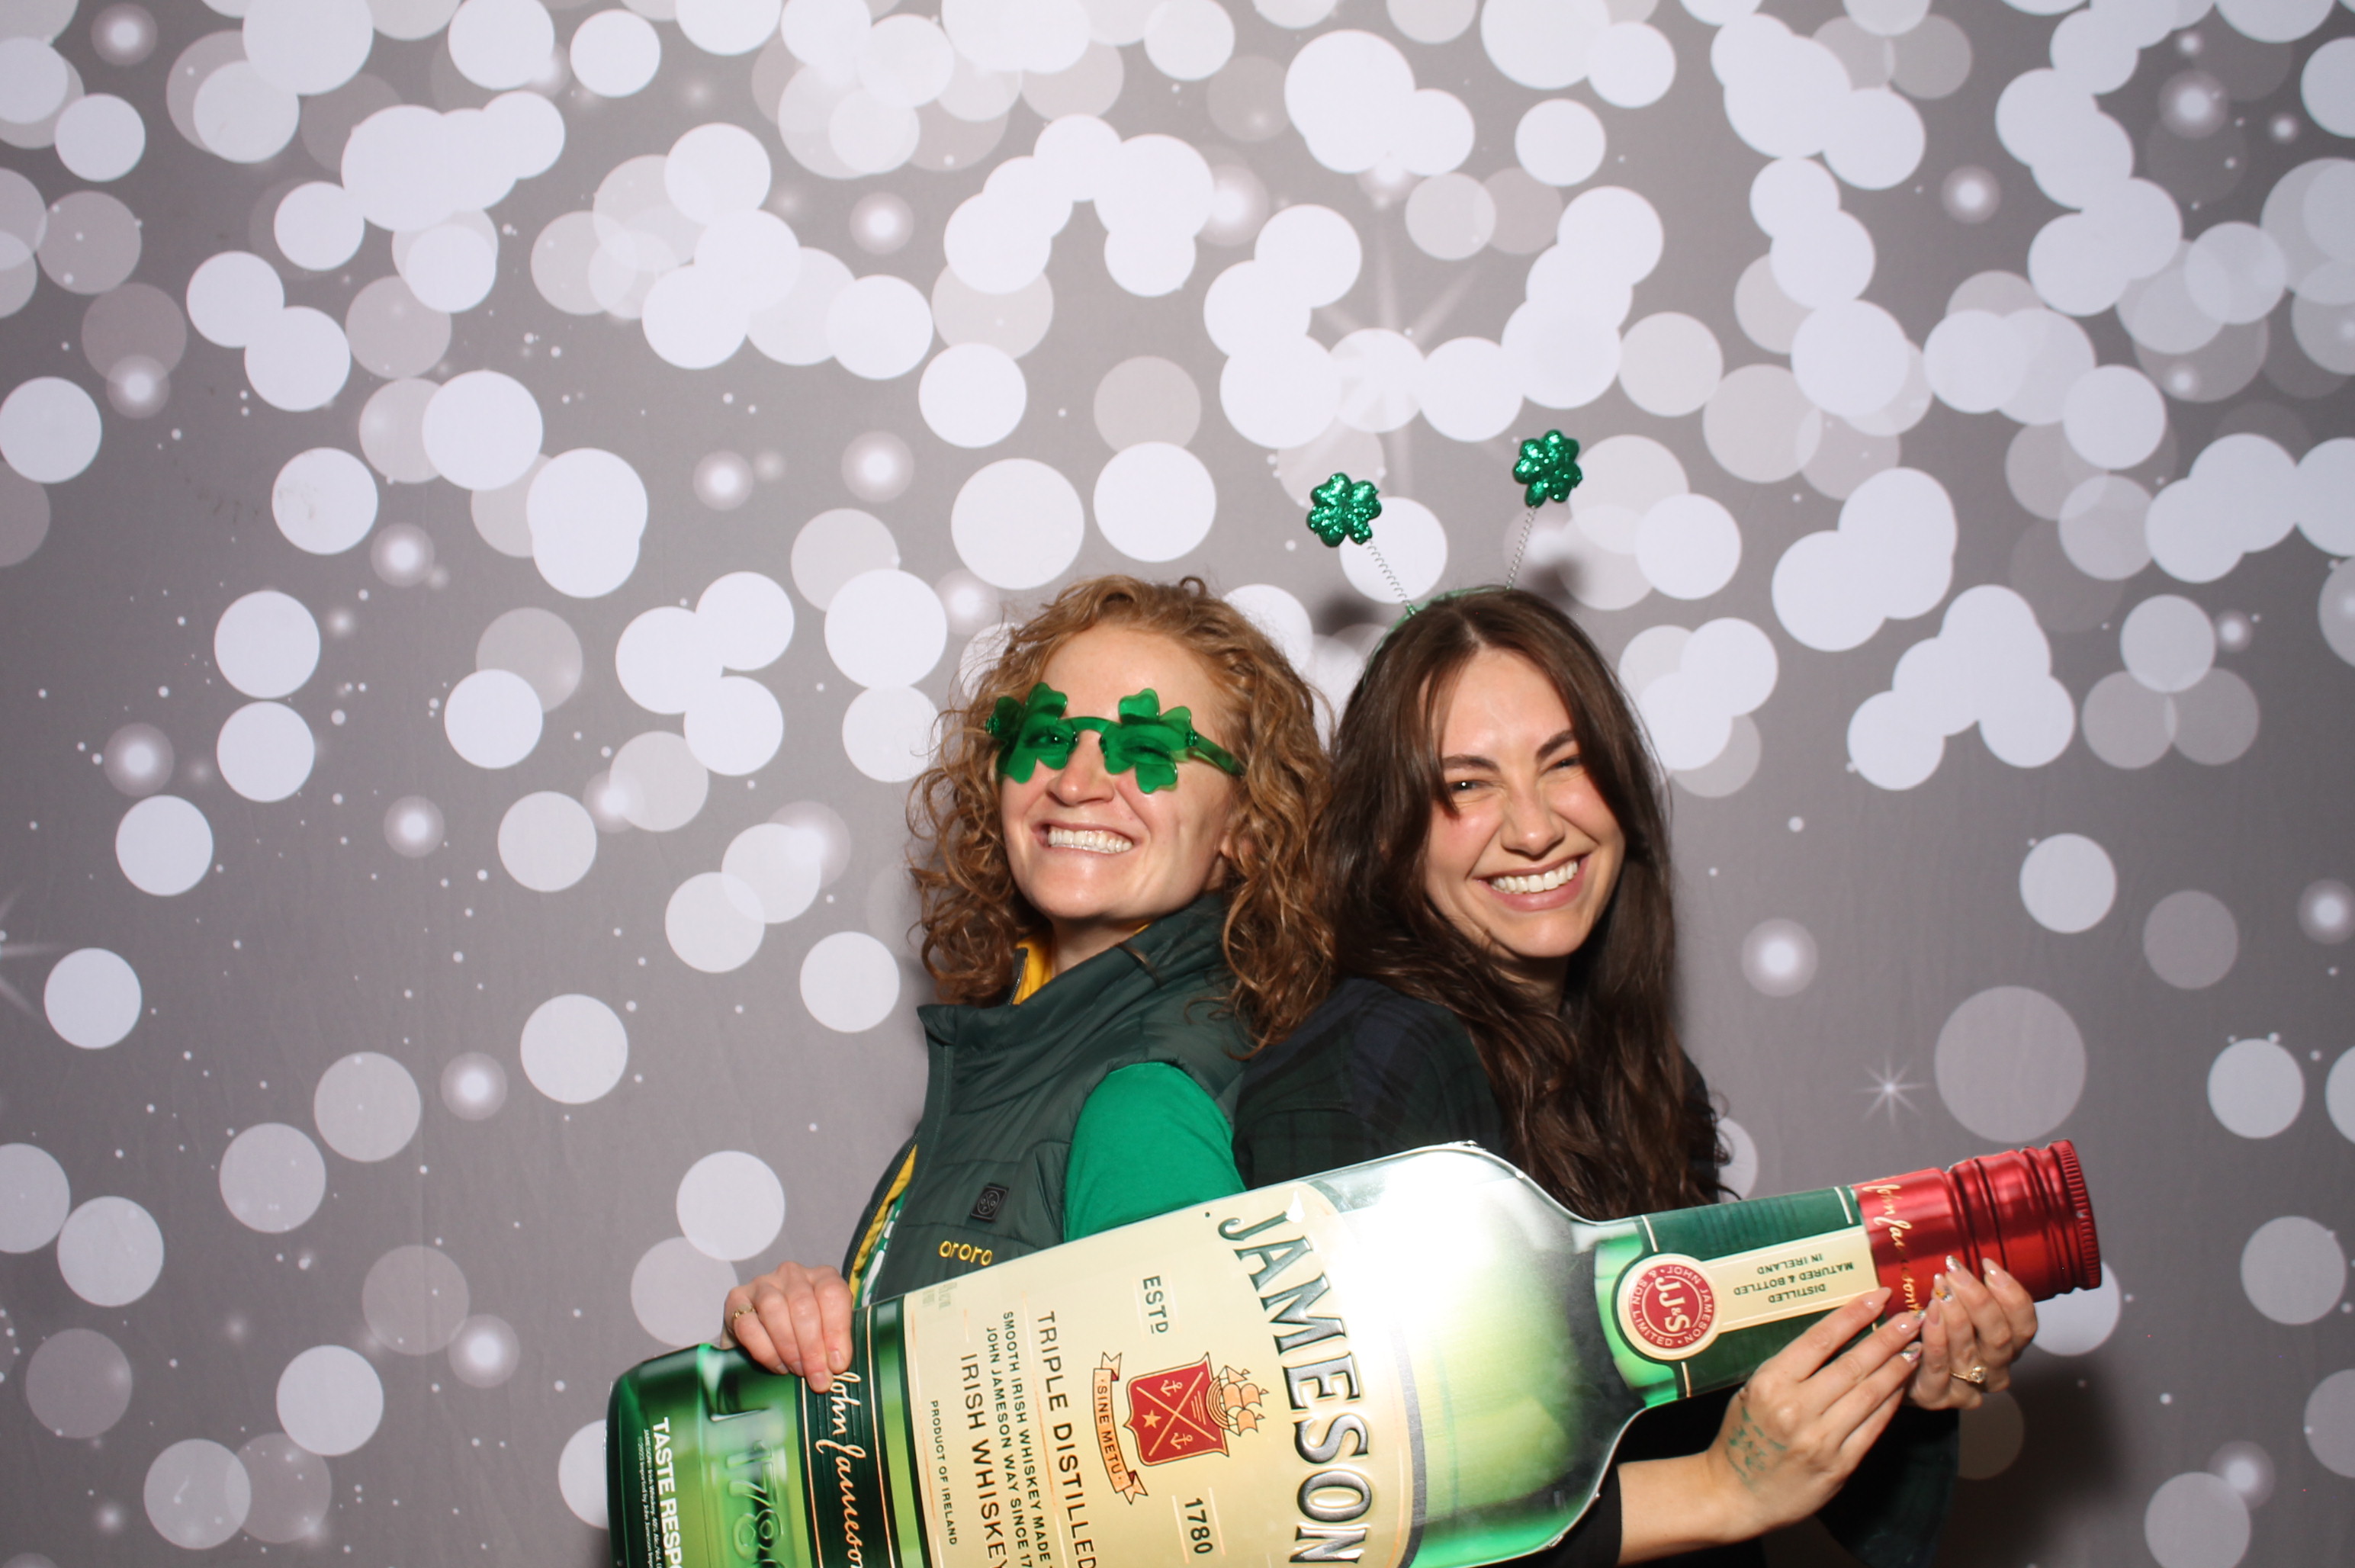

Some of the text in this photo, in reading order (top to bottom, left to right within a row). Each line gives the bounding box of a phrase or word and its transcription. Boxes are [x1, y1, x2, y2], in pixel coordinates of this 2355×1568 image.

[1862, 1184, 1902, 1216] John
[939, 1240, 993, 1266] ororo
[1733, 1261, 1854, 1296] MATURED & BOTTLED
[1757, 1253, 1823, 1275] IN IRELAND
[1632, 1279, 1647, 1305] SON
[1667, 1266, 1714, 1343] JOHN JAMESON
[1768, 1284, 1826, 1303] DISTILLED
[986, 1327, 1000, 1364] JOHN
[1633, 1311, 1673, 1346] LIMITED
[831, 1372, 861, 1435] John
[991, 1367, 1012, 1448] JAMESON
[1216, 1210, 1372, 1563] JAMESON
[1003, 1311, 1051, 1562] SMOOTH IRISH WHISKEY MADE
[1037, 1310, 1097, 1568] TRIPLE DISTILLED
[1097, 1385, 1122, 1474] SINE METU
[930, 1400, 958, 1546] PRODUCT OF IRELAND
[960, 1353, 1008, 1568] IRISH WHISKEY
[1004, 1454, 1020, 1492] WAY
[653, 1417, 683, 1568] TASTE RESP
[727, 1440, 785, 1568] 178
[1010, 1498, 1029, 1550] SINCE
[1184, 1497, 1213, 1555] 1780
